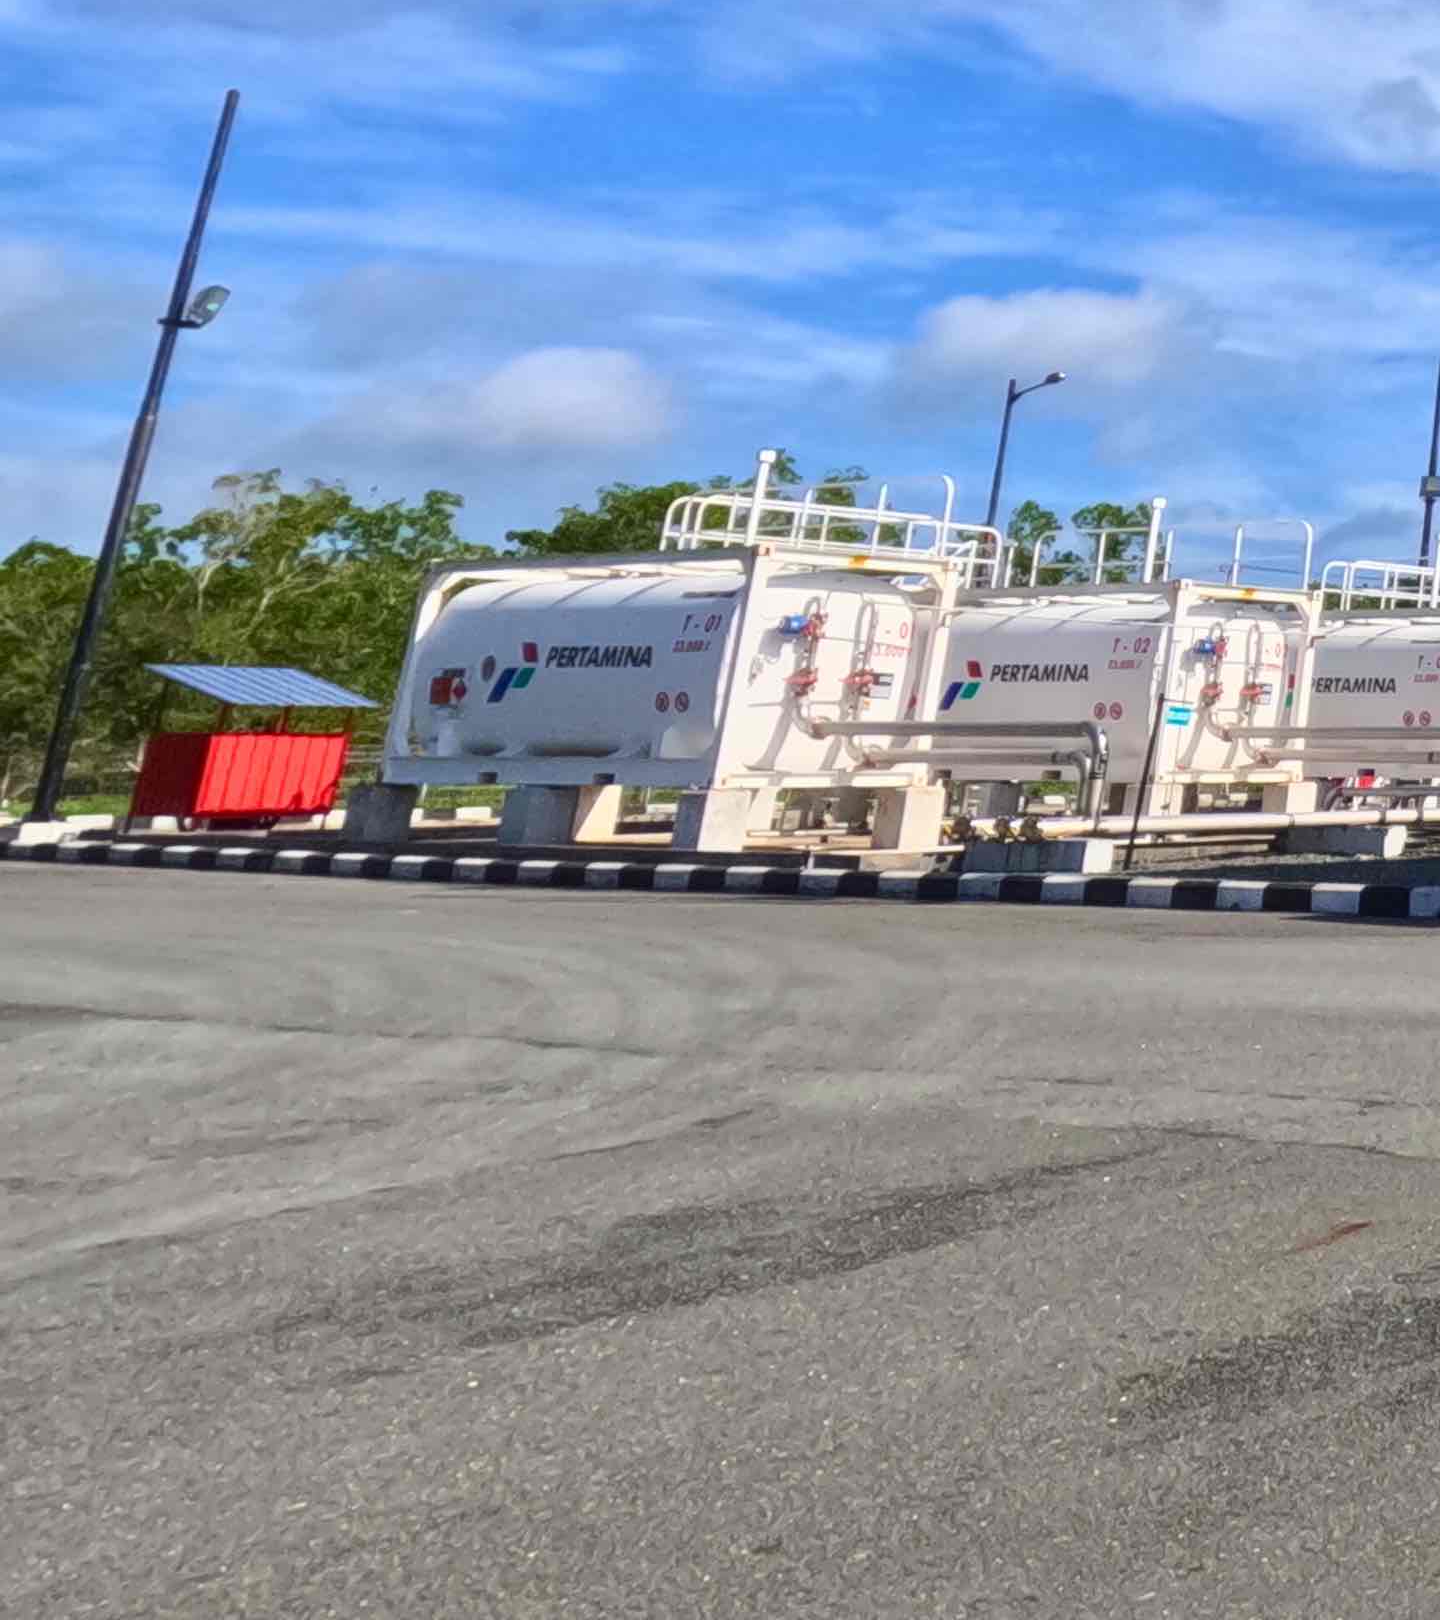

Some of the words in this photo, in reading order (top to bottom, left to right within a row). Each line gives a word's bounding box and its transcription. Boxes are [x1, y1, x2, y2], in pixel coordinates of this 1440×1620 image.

[704, 614, 722, 632] 01
[1133, 637, 1151, 653] 02
[545, 646, 653, 668] PERTAMINA
[990, 664, 1089, 682] PERTAMINA
